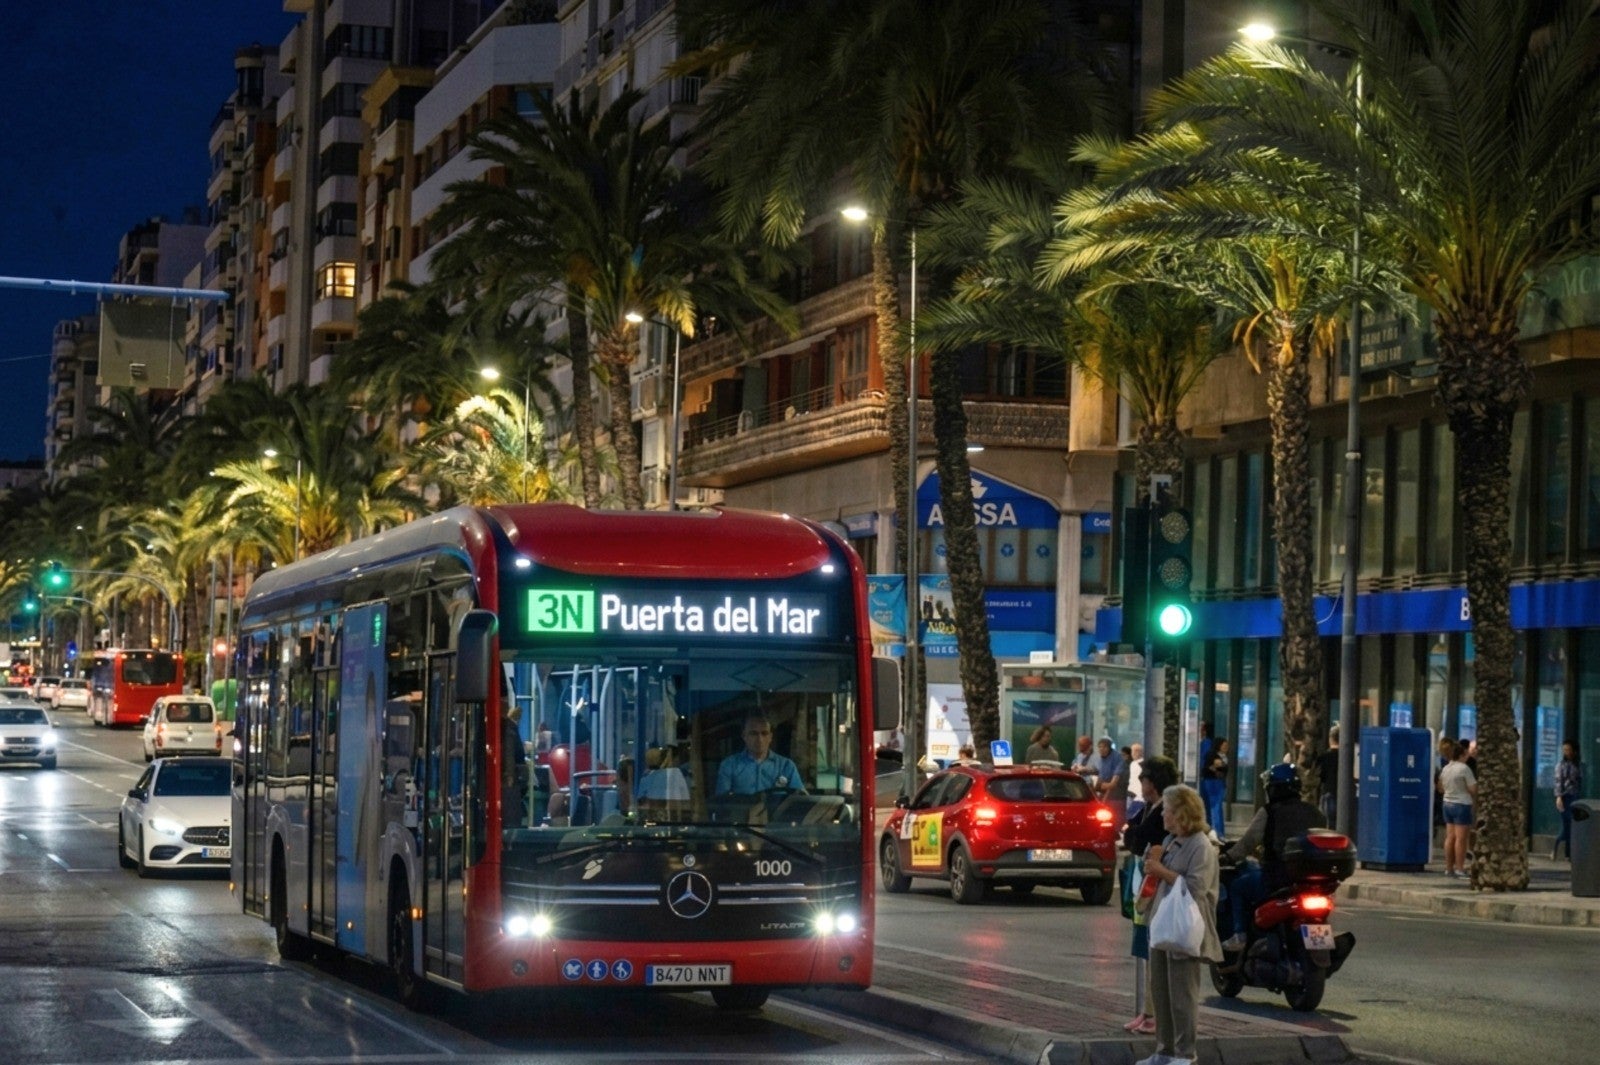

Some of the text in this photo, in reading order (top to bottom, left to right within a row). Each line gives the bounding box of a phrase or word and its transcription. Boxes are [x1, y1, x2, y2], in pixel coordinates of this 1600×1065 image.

[927, 502, 1018, 526] ASSA
[537, 593, 820, 634] 3N Puerta del Mar
[753, 860, 792, 876] 1000
[655, 967, 726, 982] 8470 NNT
